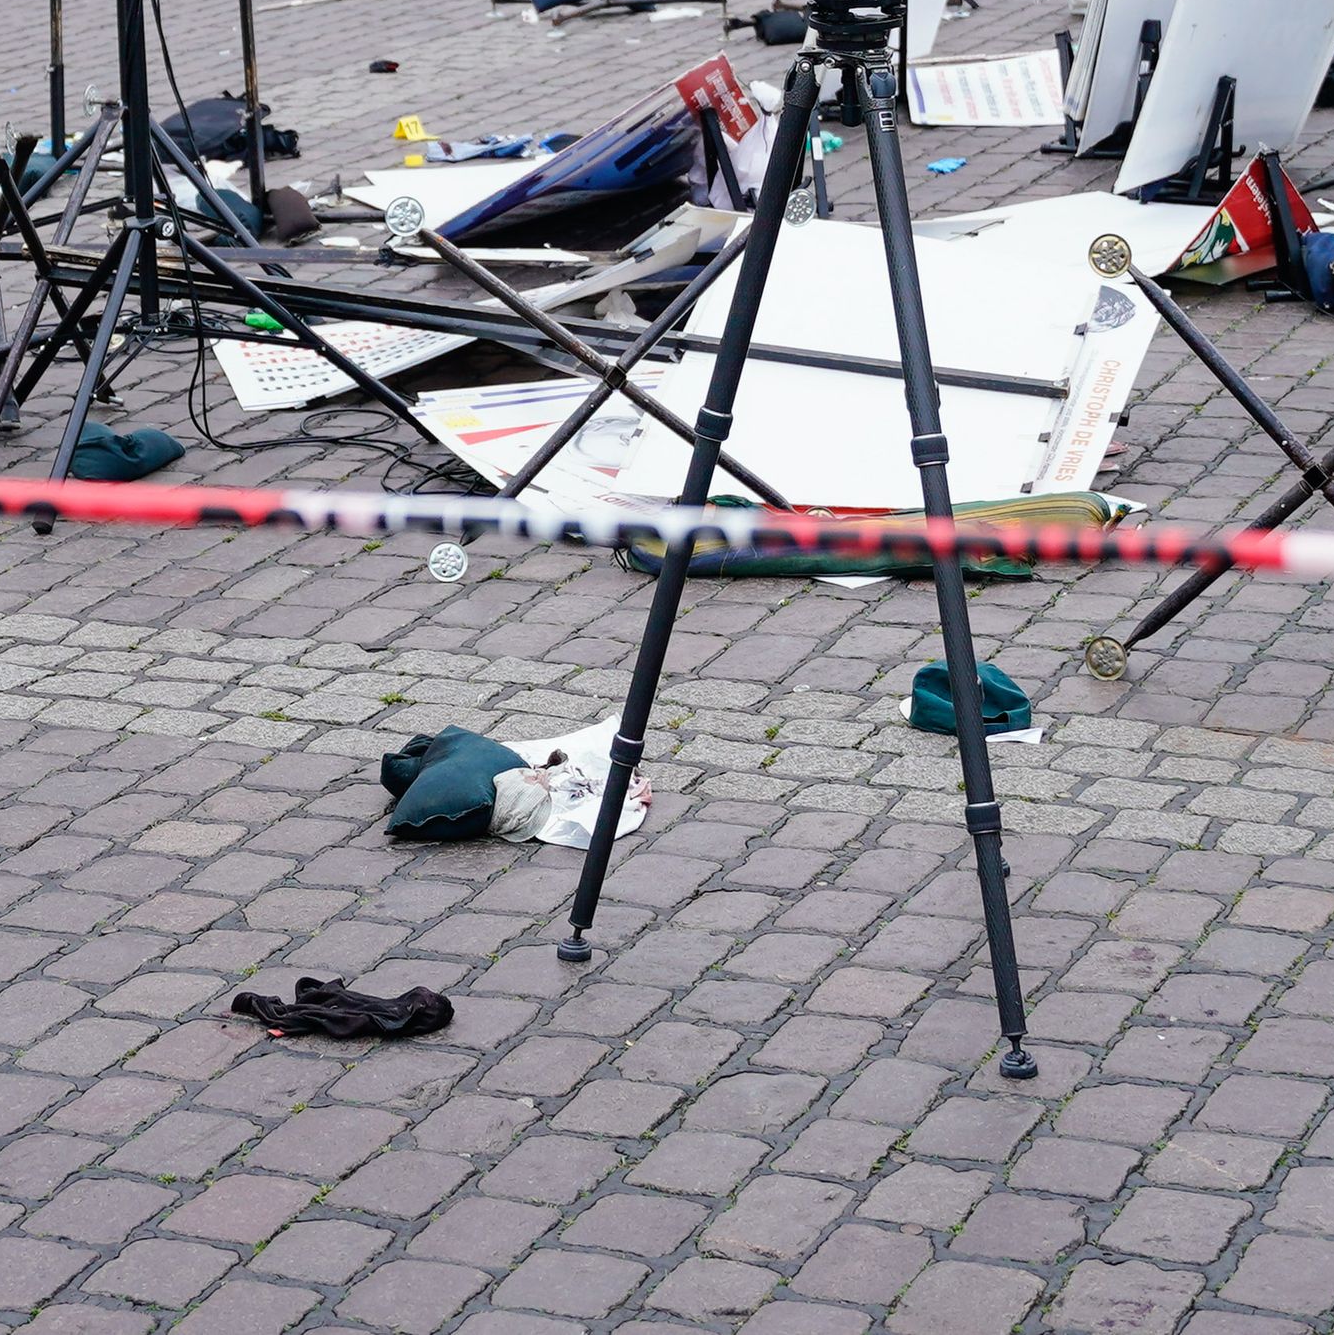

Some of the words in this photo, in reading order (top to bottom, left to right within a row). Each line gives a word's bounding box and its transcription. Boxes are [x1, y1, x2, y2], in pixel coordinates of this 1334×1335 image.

[405, 120, 419, 136] 17
[1079, 359, 1122, 429] CHRISTOPH
[1071, 430, 1094, 447] DE
[1054, 450, 1084, 482] VRIES
